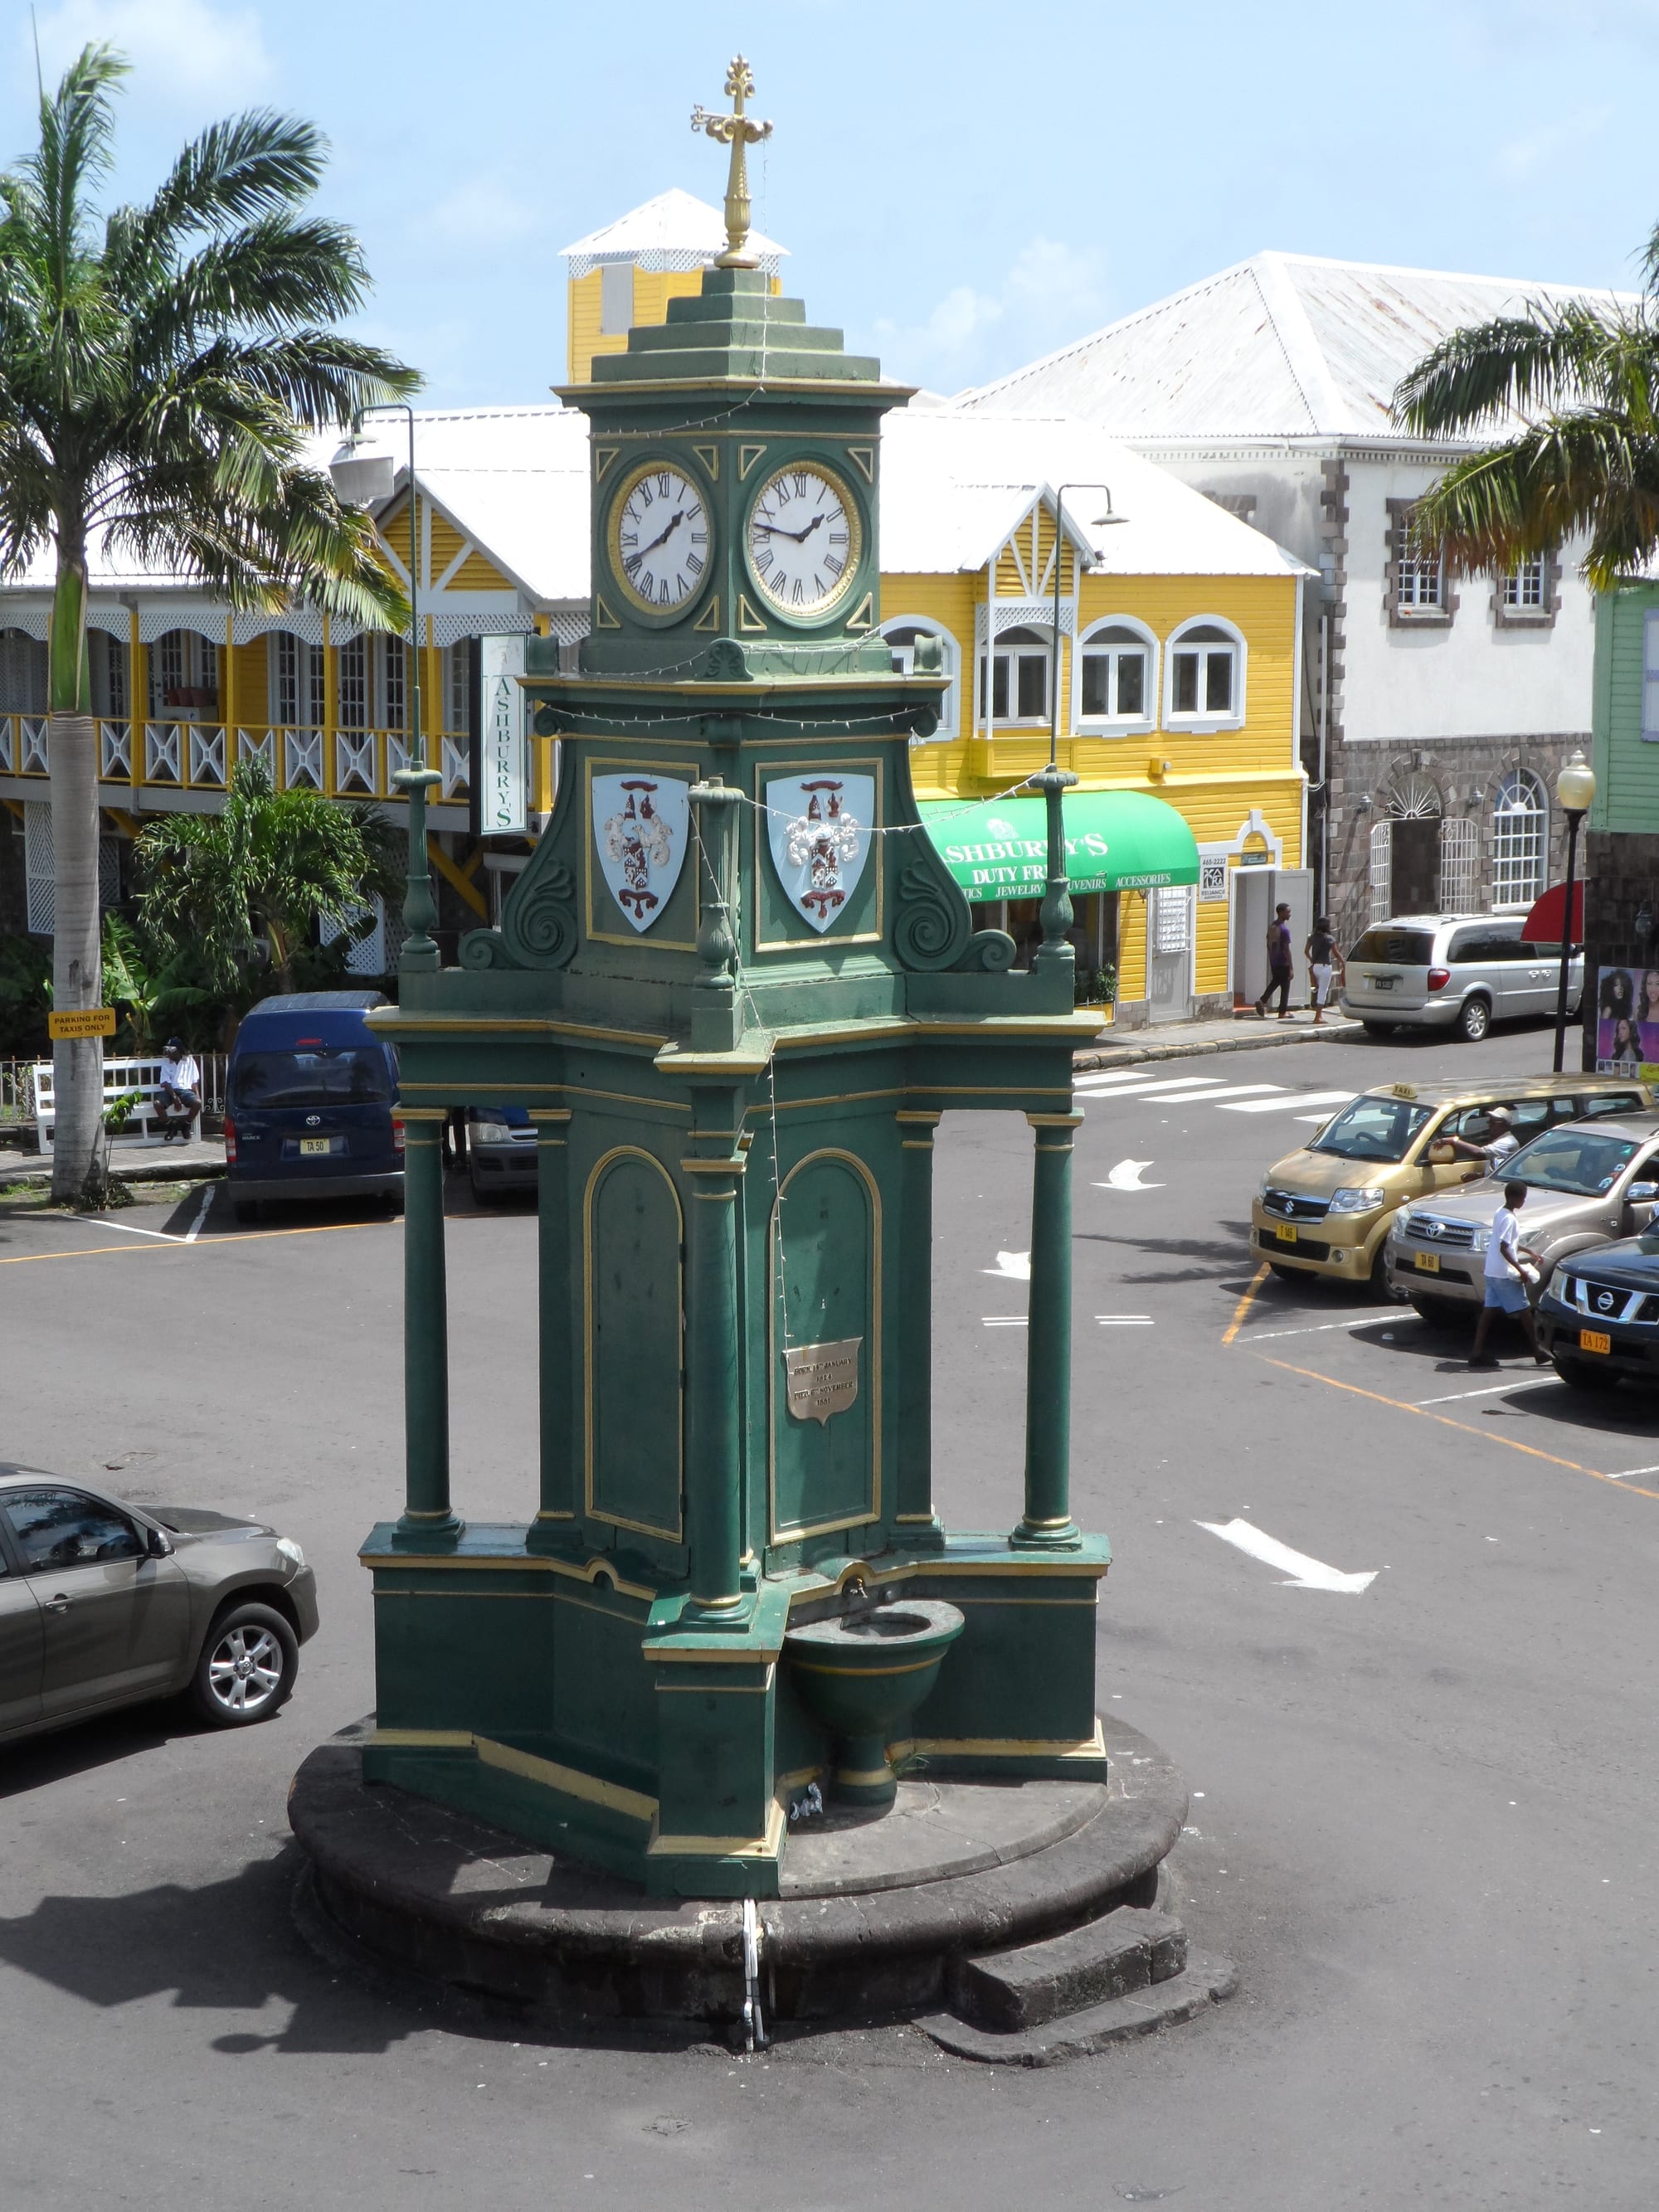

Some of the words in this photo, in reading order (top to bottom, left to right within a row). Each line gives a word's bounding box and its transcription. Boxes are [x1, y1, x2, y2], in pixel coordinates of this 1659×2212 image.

[494, 676, 512, 828] ASHBURRY'S
[944, 833, 1108, 863] SHBURY'S
[973, 867, 1017, 884] DUTY
[995, 884, 1044, 897] JEWELRY
[1067, 878, 1107, 890] UVENIRS
[1116, 873, 1171, 887] ACCESSORIES
[54, 1015, 91, 1024] PARKING
[60, 1024, 82, 1033] TAXIS
[1395, 1086, 1410, 1095] TAXI
[306, 1141, 314, 1152] TA
[316, 1140, 324, 1151] 50
[1582, 1333, 1593, 1348] TA
[1595, 1335, 1608, 1350] 172
[824, 1358, 852, 1369] JANUARY
